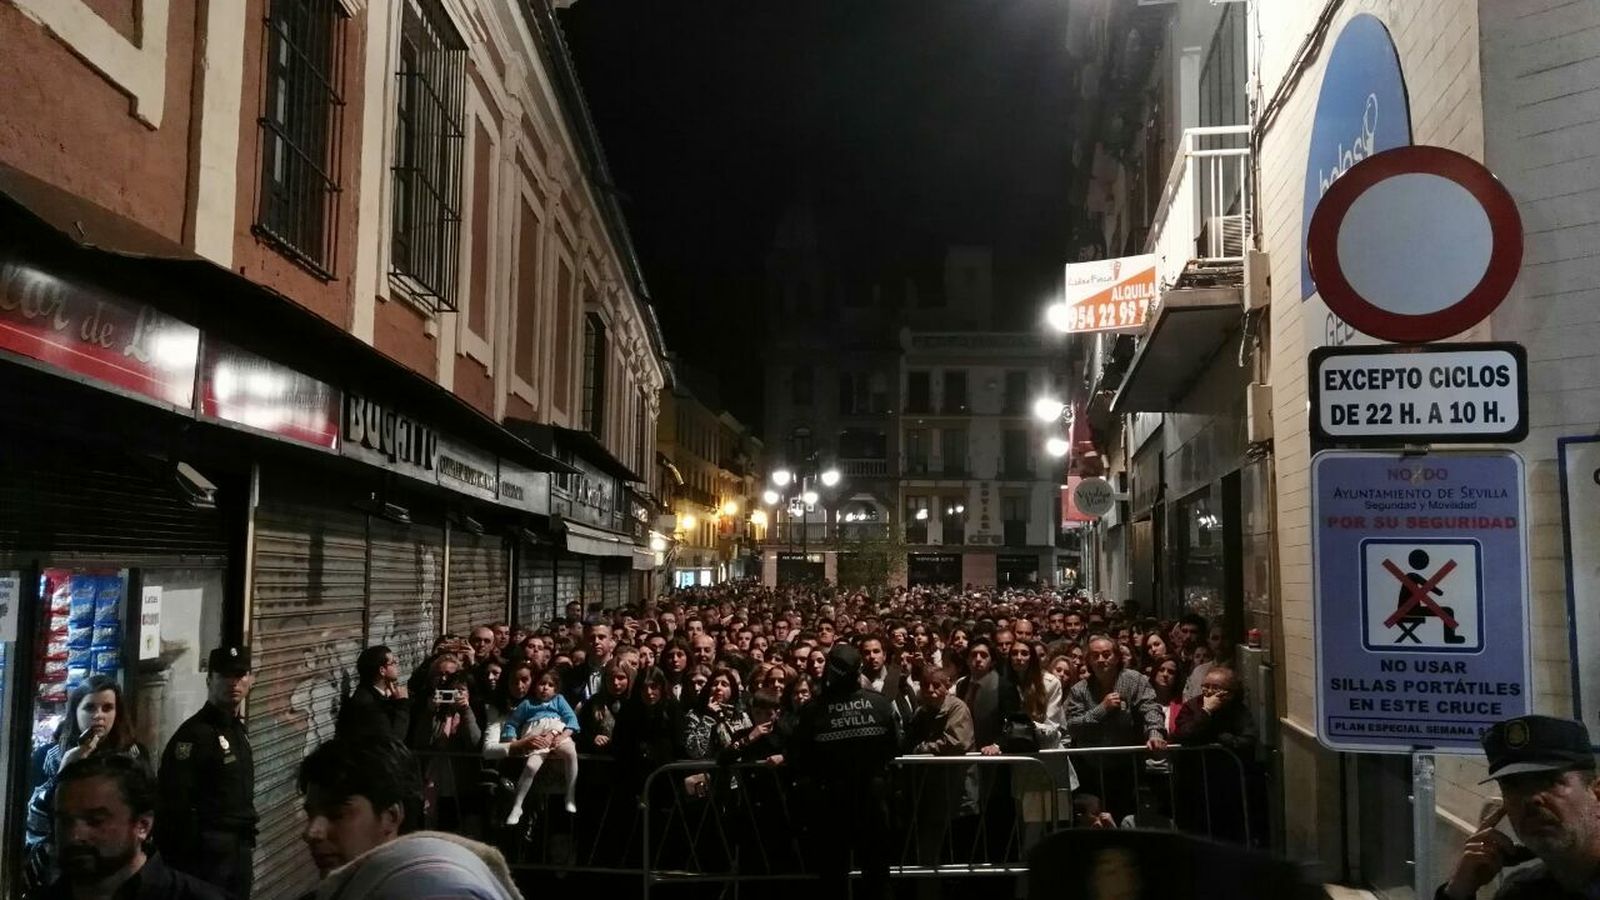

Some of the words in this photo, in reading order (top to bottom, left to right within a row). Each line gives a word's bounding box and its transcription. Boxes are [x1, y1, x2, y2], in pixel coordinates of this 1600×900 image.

[1111, 282, 1156, 301] ALQUILA
[1098, 302, 1116, 327] 22
[1324, 367, 1422, 391] EXCEPTO
[1429, 364, 1511, 388] CICLOS
[1331, 404, 1359, 426] DE
[1366, 403, 1393, 425] 22
[1400, 403, 1422, 424] H.
[1428, 402, 1443, 424] A
[1450, 402, 1475, 423] 10
[1483, 401, 1506, 422] H.
[1364, 500, 1416, 512] Seguridad
[1419, 502, 1425, 512] y
[1327, 516, 1366, 530] POR
[1374, 516, 1399, 529] SU
[1406, 515, 1518, 530] SEGURIDAD
[1380, 660, 1406, 673] NO
[1414, 660, 1467, 674] USAR
[1331, 678, 1397, 693] SILLAS
[1403, 678, 1521, 696] PORTÁTILES
[1349, 698, 1374, 711] EN
[1381, 699, 1430, 713] ESTE
[1437, 701, 1502, 716] CRUCE
[830, 714, 877, 729] SEVILLA
[1334, 723, 1365, 732] PLAN
[1368, 723, 1423, 734] ESPECIAL
[1426, 725, 1474, 735] SEMANA
